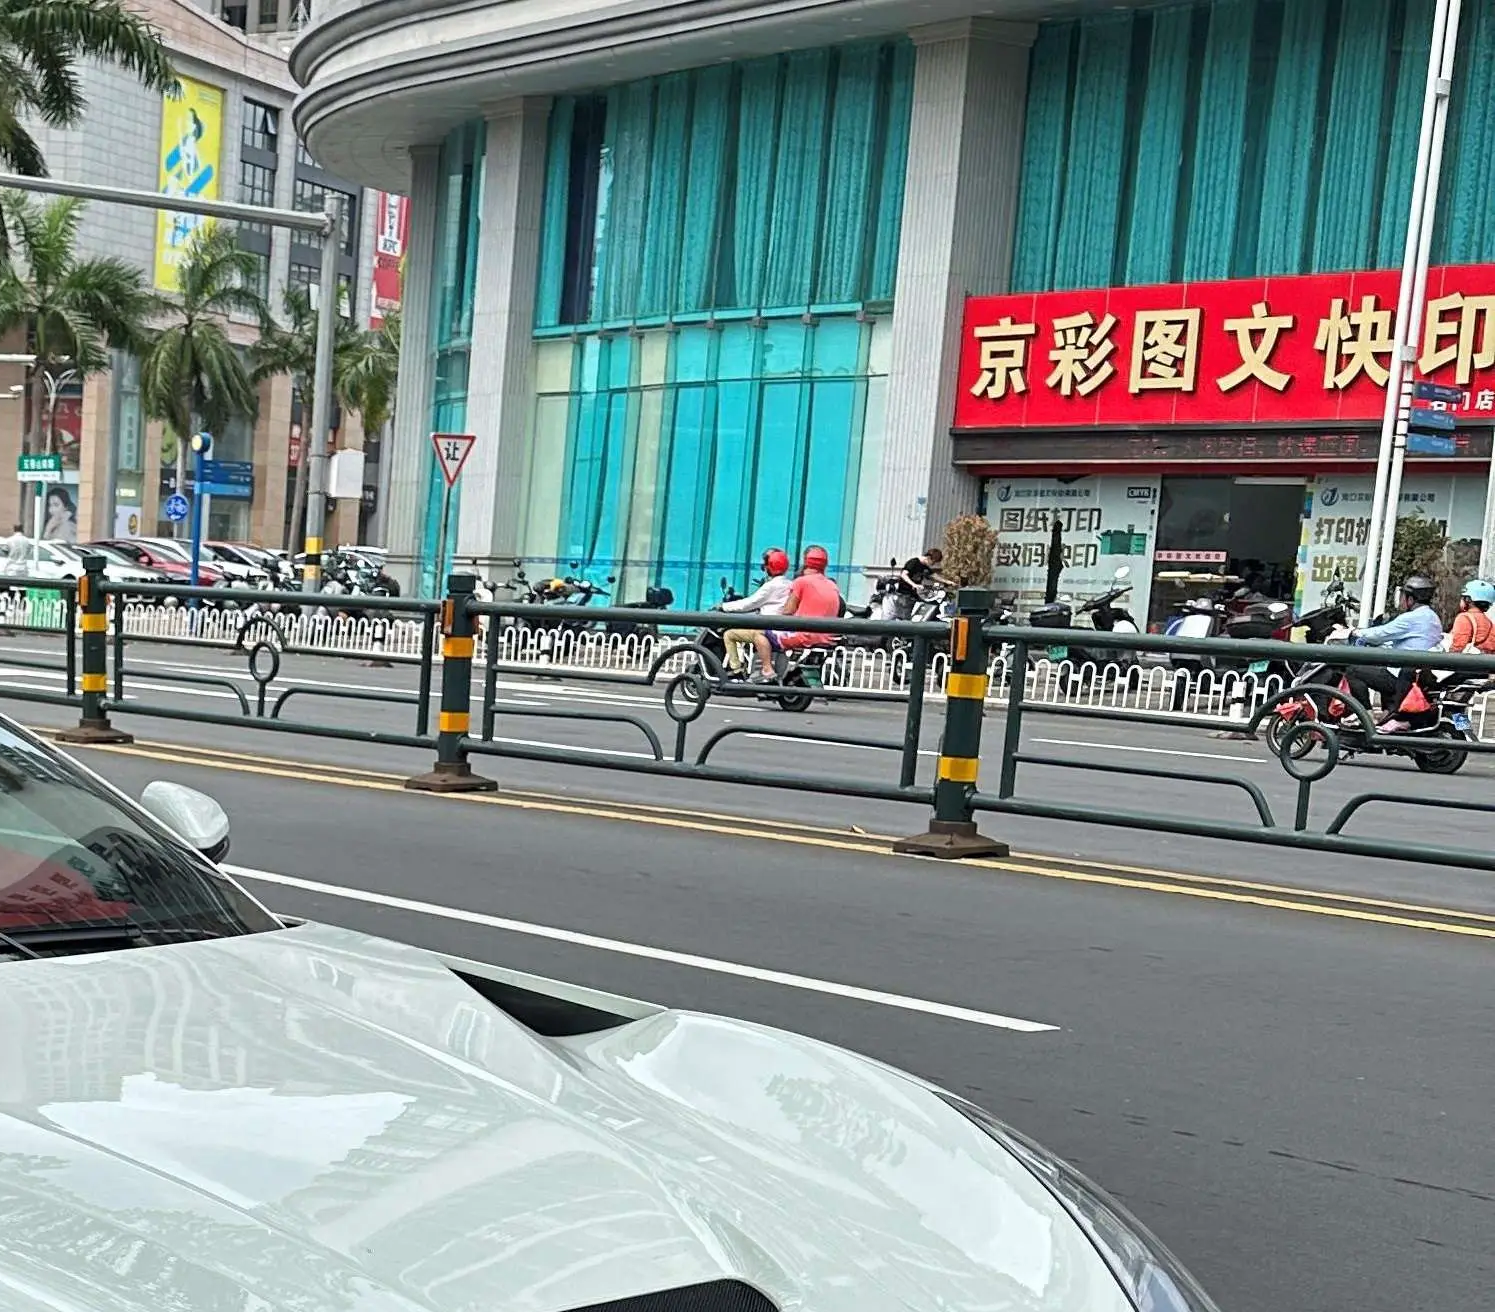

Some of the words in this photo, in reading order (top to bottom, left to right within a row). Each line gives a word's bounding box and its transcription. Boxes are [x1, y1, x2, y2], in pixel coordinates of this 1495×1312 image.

[970, 292, 1495, 399] 京彩图文快印
[444, 441, 459, 461] 让
[999, 507, 1102, 533] 图纸打印
